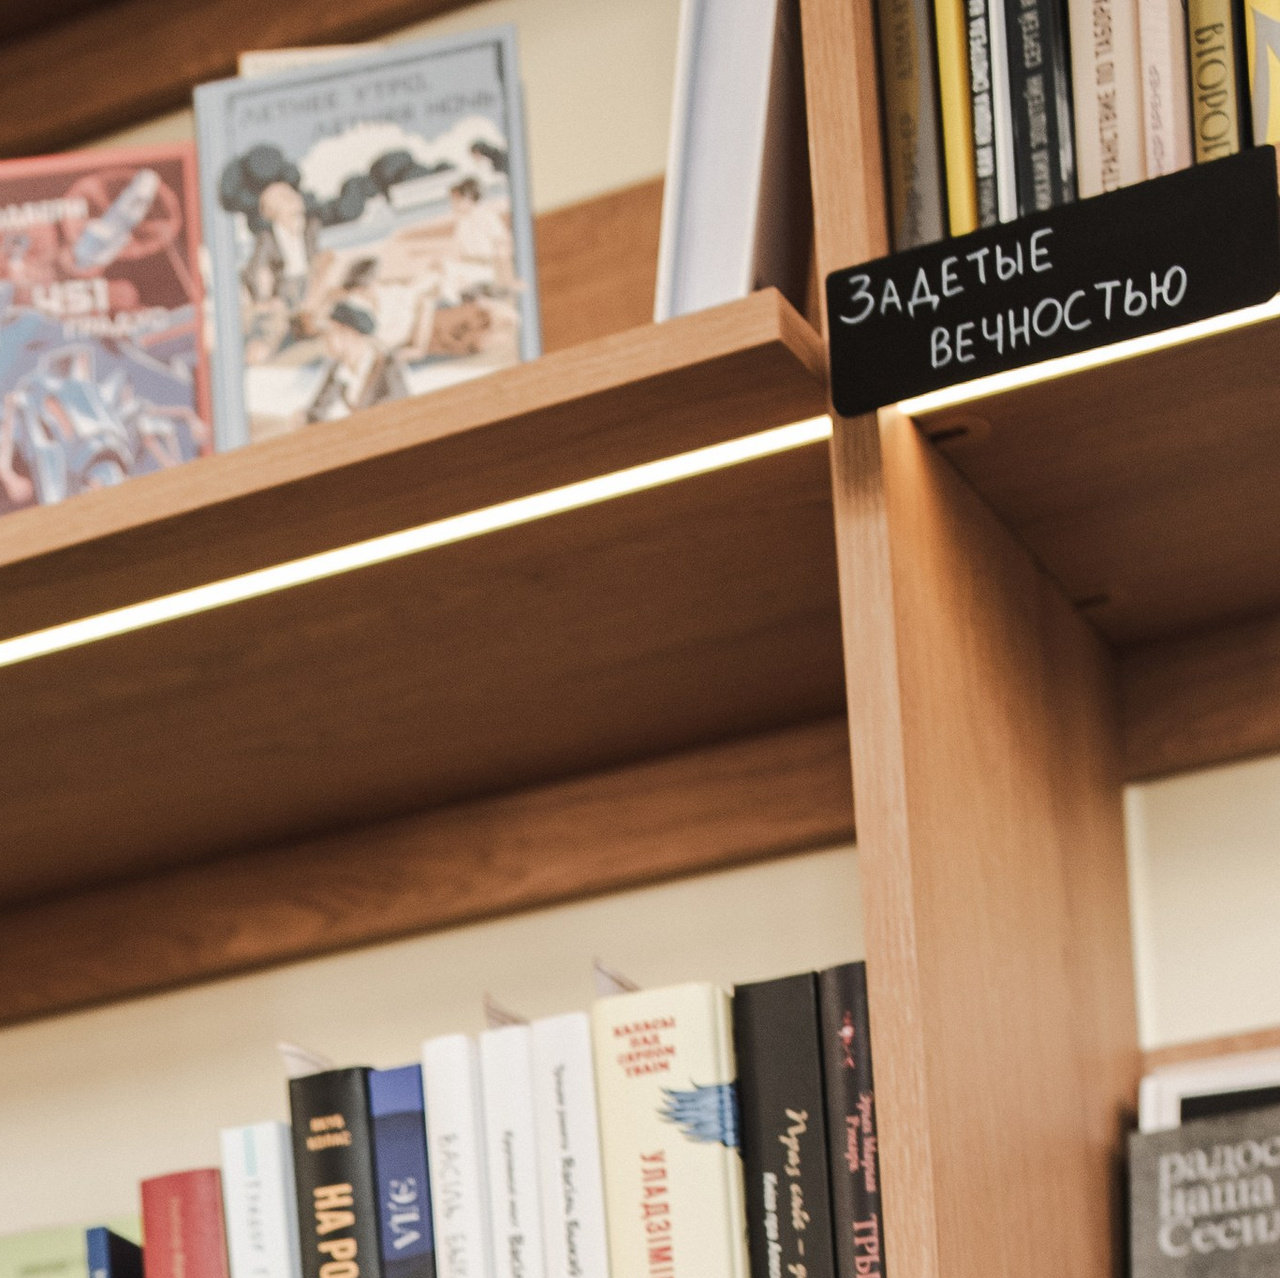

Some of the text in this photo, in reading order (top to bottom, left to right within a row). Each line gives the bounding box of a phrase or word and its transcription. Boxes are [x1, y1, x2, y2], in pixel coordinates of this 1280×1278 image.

[839, 228, 1054, 325] ЗАДЕТЫЕ
[930, 265, 1188, 369] ВЕЧНОСТЬЮ
[313, 1182, 356, 1236] НА
